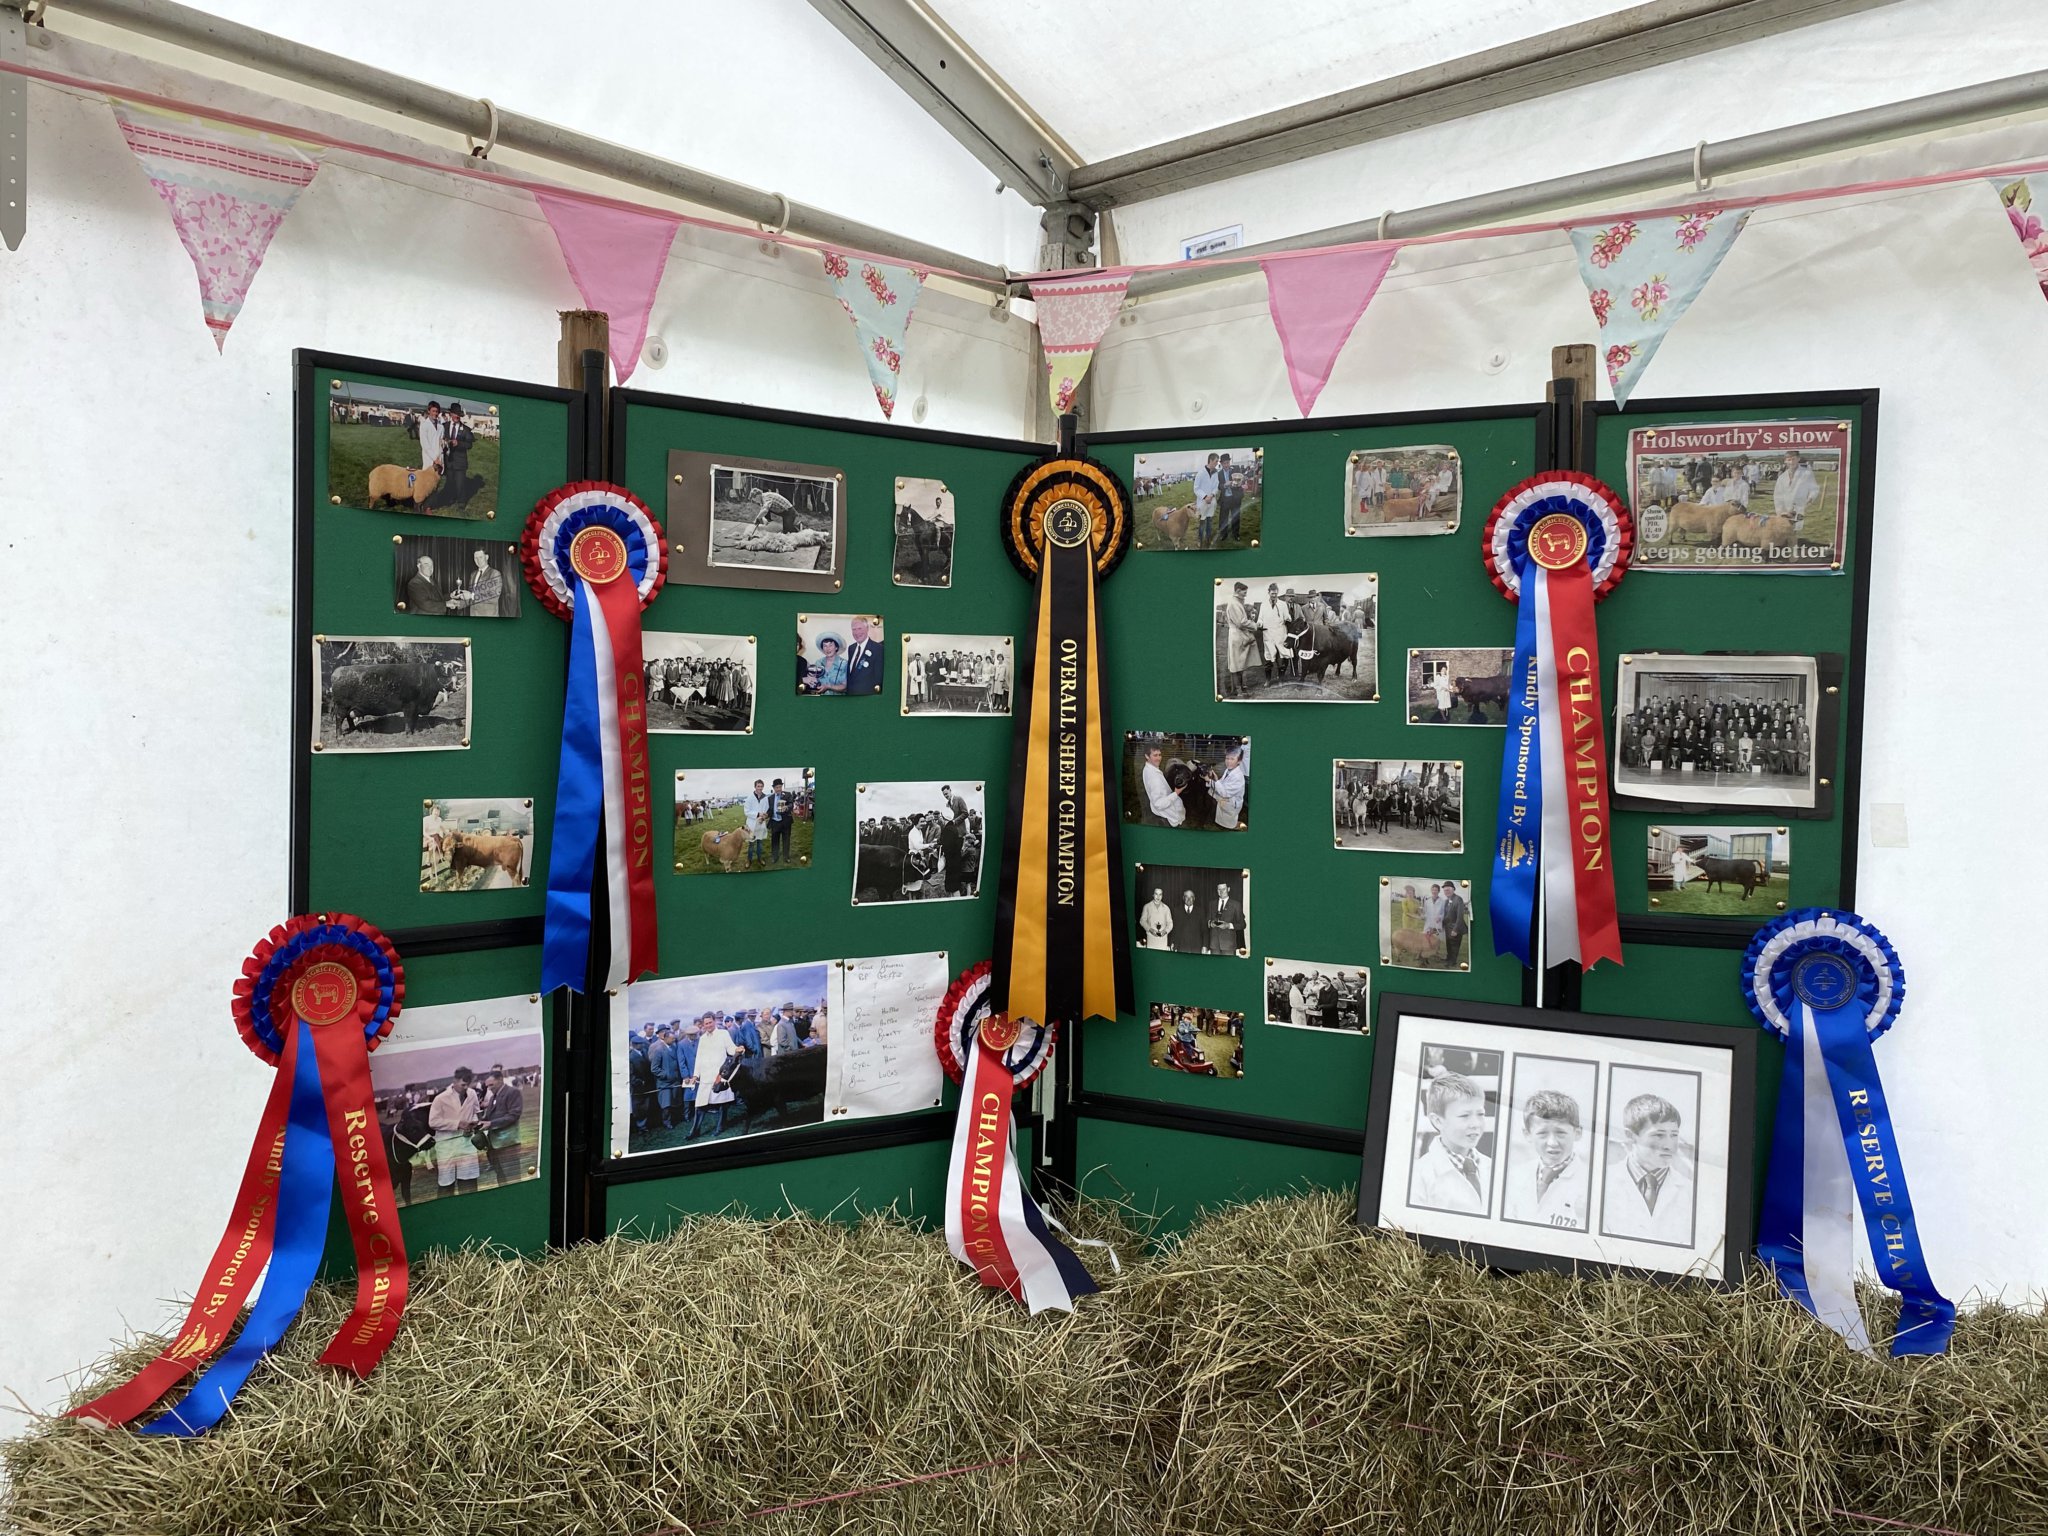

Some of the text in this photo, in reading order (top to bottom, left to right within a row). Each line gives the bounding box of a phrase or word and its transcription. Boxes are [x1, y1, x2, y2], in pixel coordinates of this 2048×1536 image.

[1778, 427, 1833, 444] show
[579, 531, 613, 545] AGRICULTURAL
[1053, 502, 1082, 513] AGRICULTURAL
[1540, 518, 1582, 537] AGRICULTURAL
[1573, 538, 1583, 555] SHOW
[1695, 544, 1763, 562] getting
[624, 672, 648, 868] CHAMPION
[1057, 638, 1077, 906] OVERALL SHEEP CHAMPION
[1514, 715, 1537, 800] Sponsored
[1566, 646, 1603, 872] CHAMPION
[1510, 804, 1527, 827] By
[297, 966, 353, 1013] LISKEARD AGRICULTURAL SHOW
[970, 1092, 1000, 1233] CHAMPION
[1848, 1087, 1895, 1207] RESERVE
[218, 1192, 271, 1287] Sponsored
[343, 1106, 394, 1345] Reserve Champion
[203, 1292, 229, 1319] By
